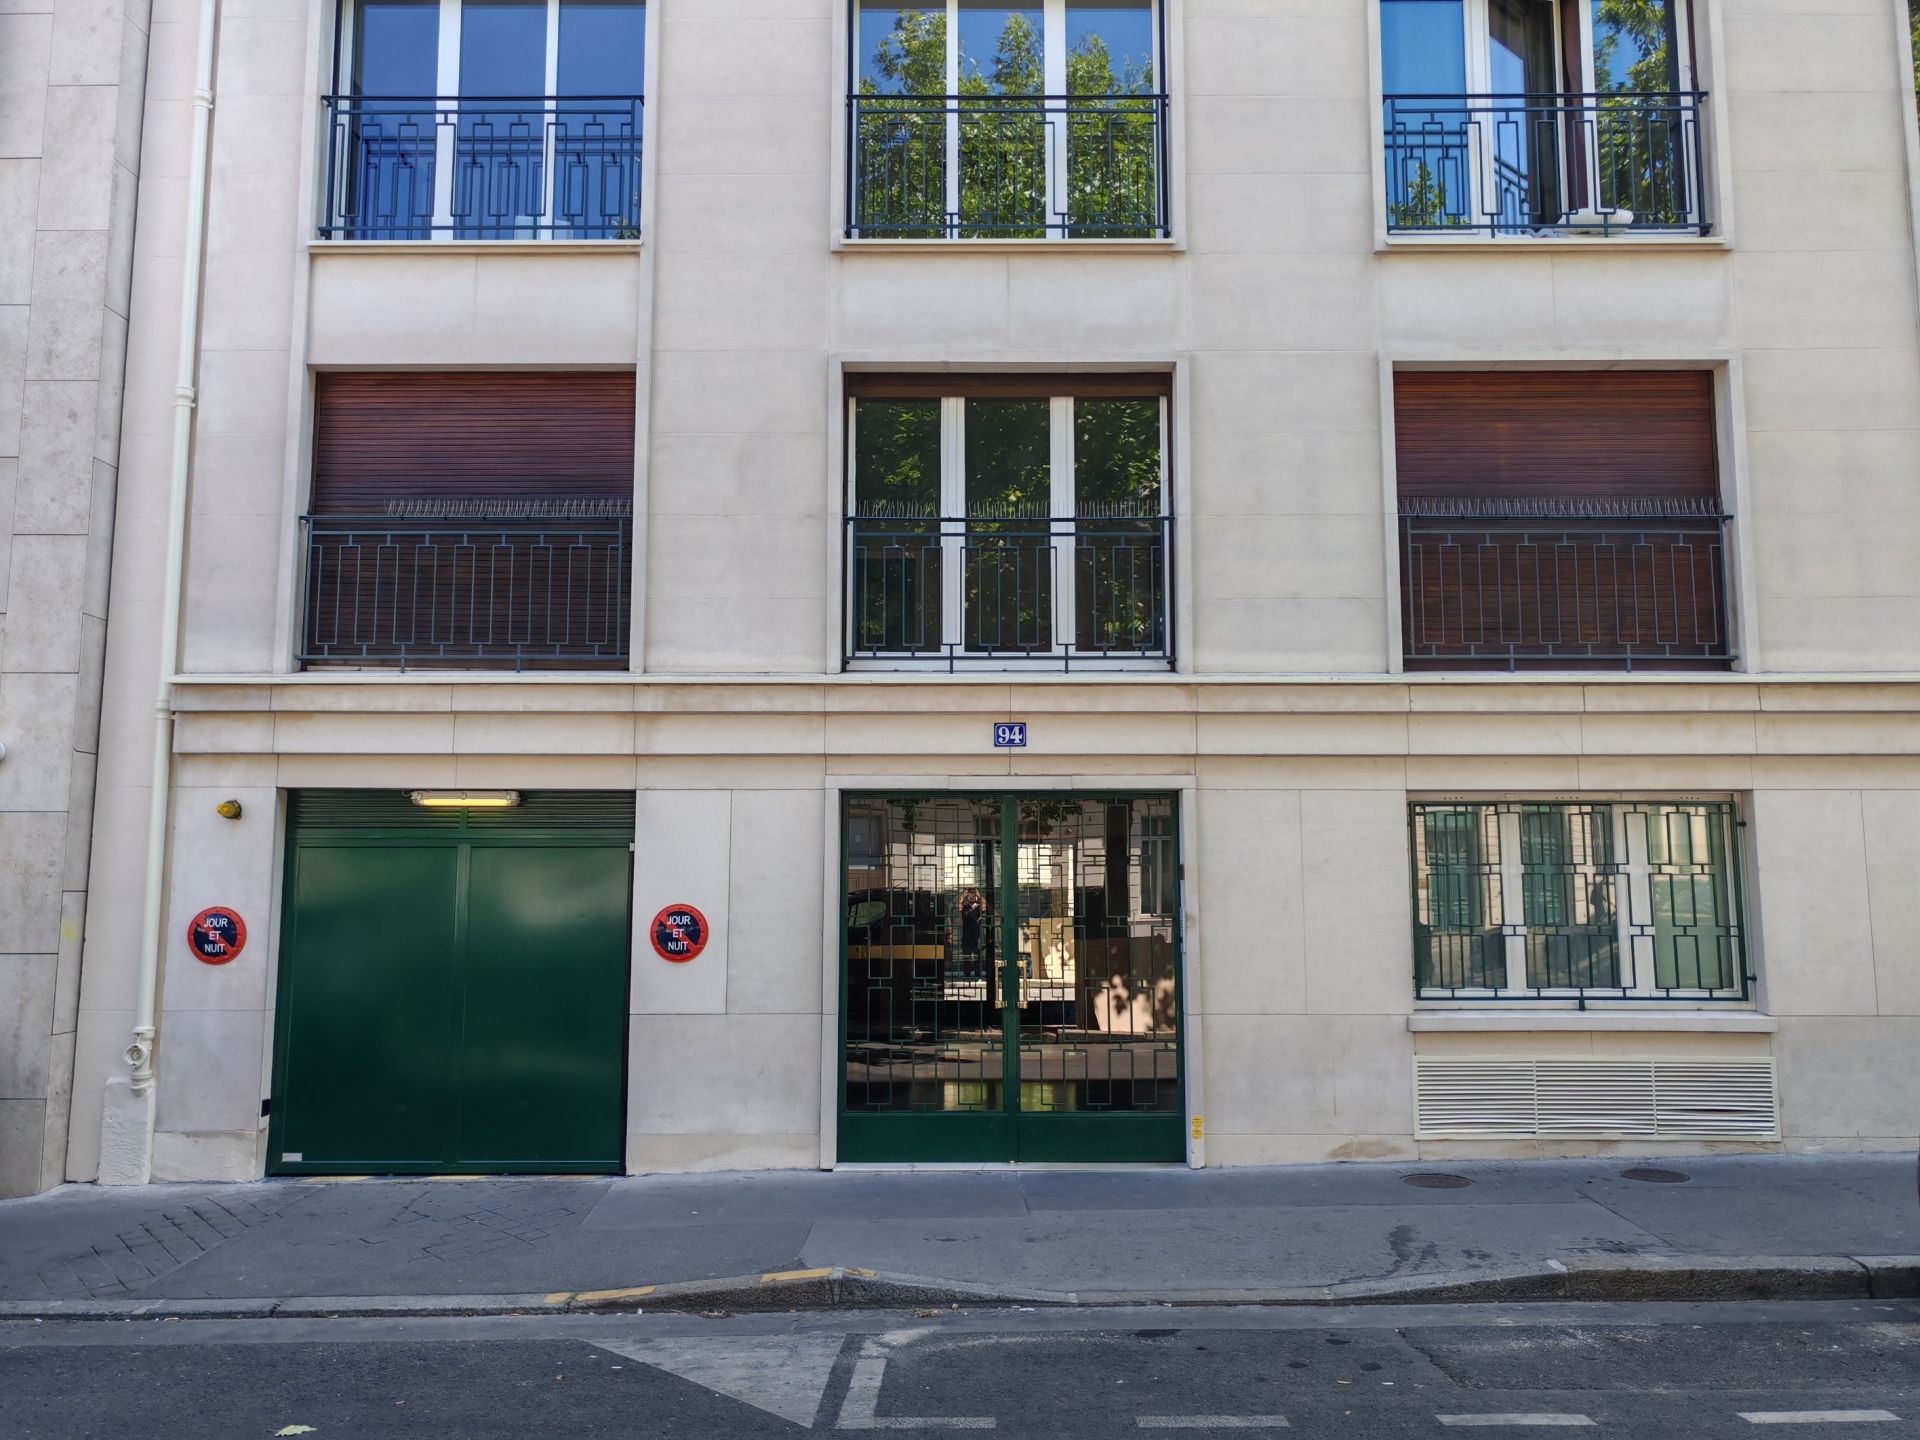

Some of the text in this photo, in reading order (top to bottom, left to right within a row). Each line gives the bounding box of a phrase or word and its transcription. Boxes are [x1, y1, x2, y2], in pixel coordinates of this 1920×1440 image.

[998, 726, 1023, 744] 94
[203, 917, 228, 928] JOUR
[667, 915, 691, 925] JOUR
[209, 930, 222, 940] ET
[672, 928, 685, 938] ET
[204, 943, 225, 953] NUIT
[667, 941, 689, 951] NUIT
